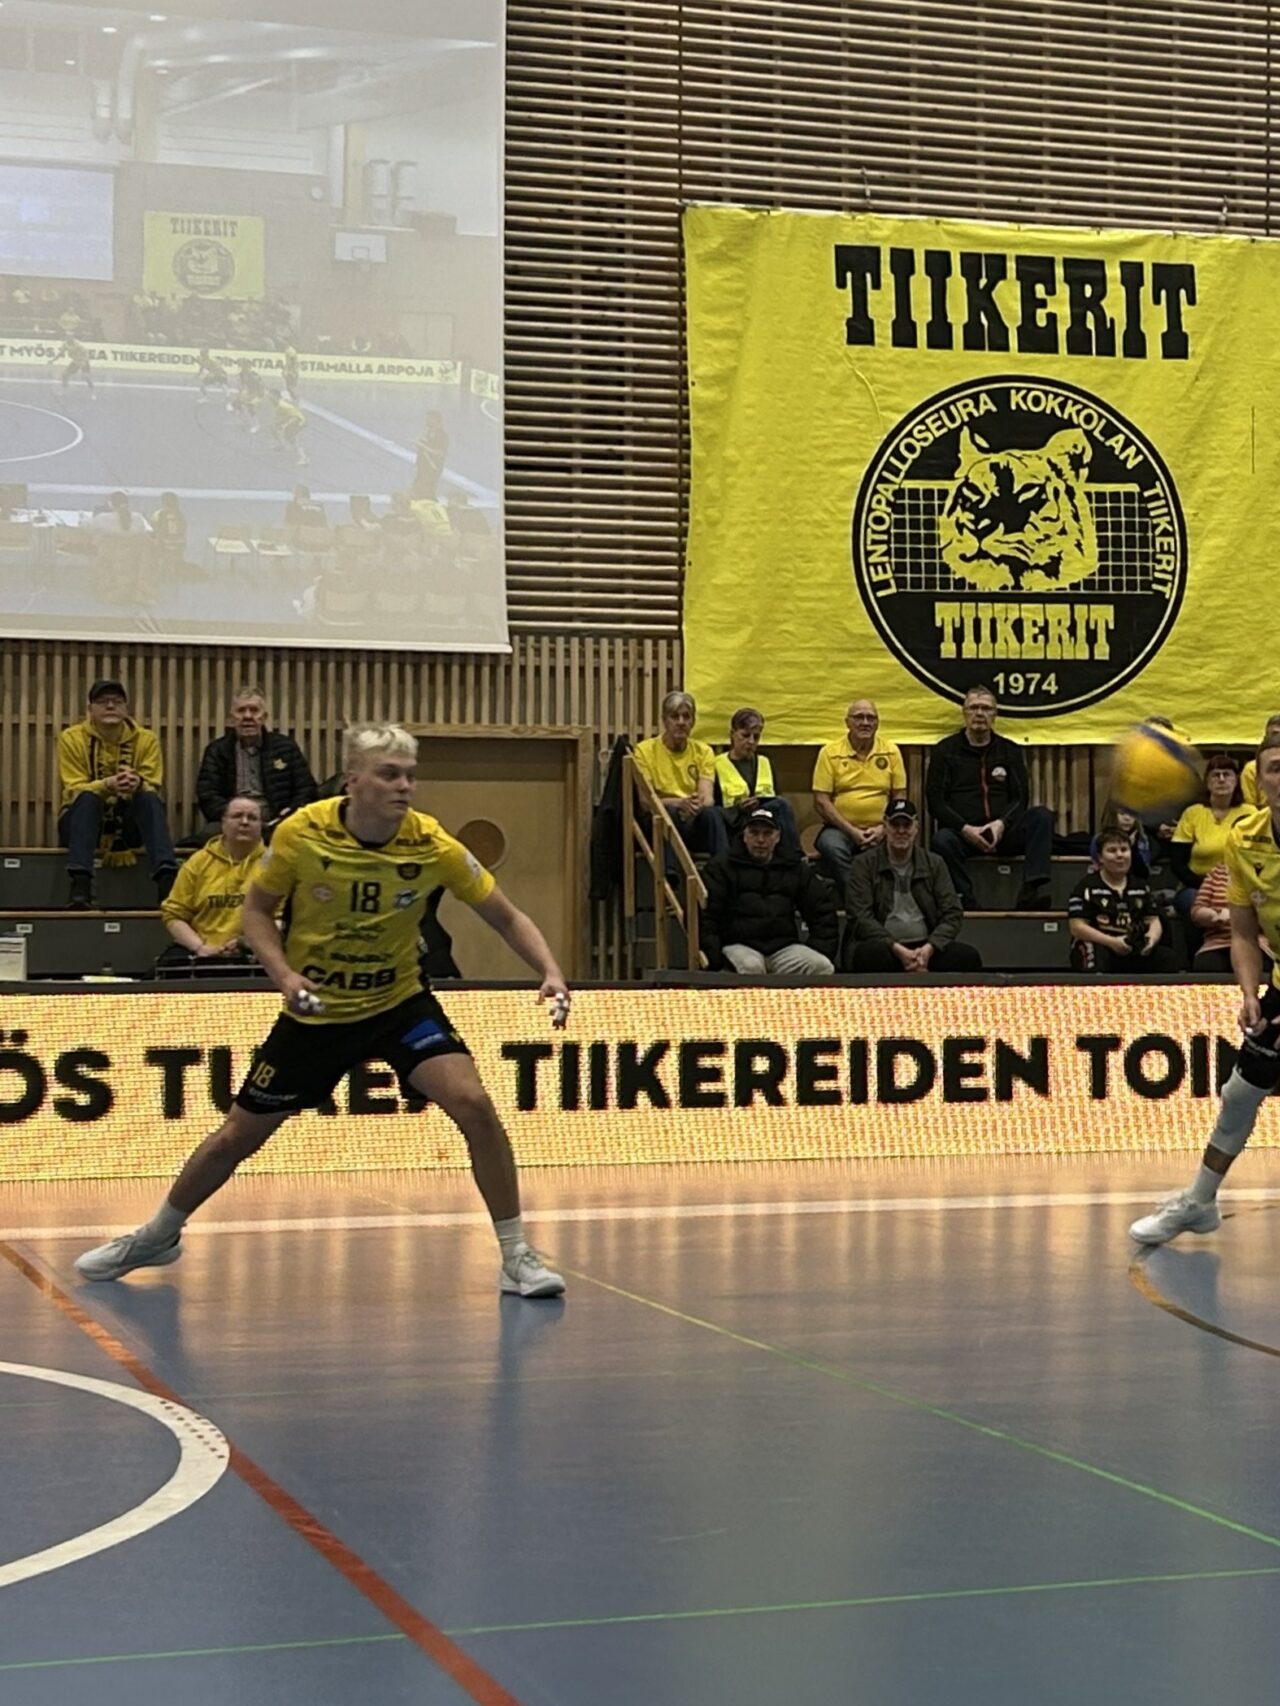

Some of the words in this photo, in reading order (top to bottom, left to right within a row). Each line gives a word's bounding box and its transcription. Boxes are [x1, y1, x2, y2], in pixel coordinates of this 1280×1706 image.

[835, 244, 1197, 360] TIIKERIT
[867, 392, 998, 598] LENTOPALLOSEURA
[1010, 389, 1144, 471] KOKKOLAN
[1143, 481, 1177, 599] TIIKERIT
[935, 602, 1115, 660] TIIKERIT
[993, 672, 1059, 695] 1974
[351, 881, 381, 913] 18
[0, 1029, 116, 1124] ÖS
[501, 1036, 1050, 1111] TIIKEREIDEN
[251, 1061, 276, 1089] 18
